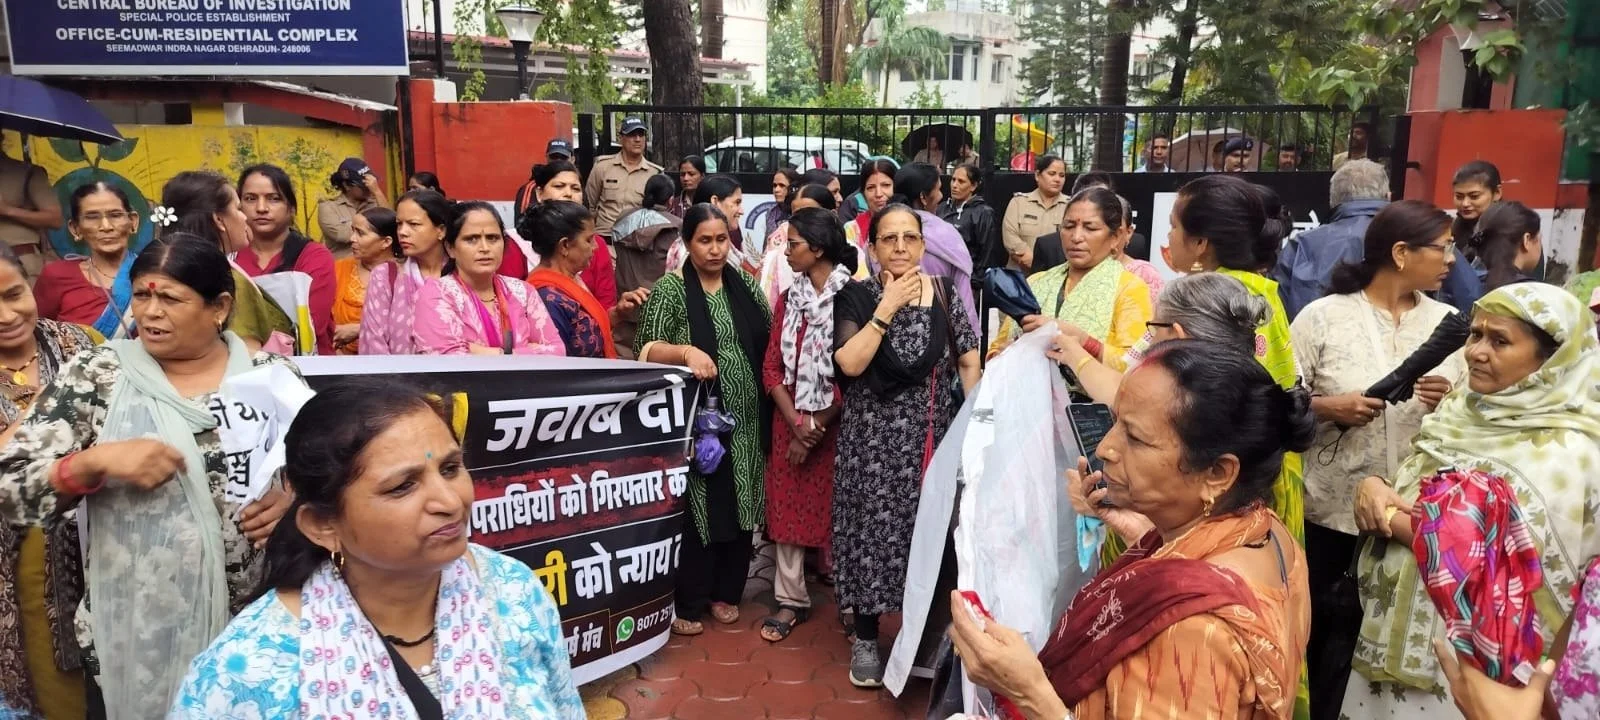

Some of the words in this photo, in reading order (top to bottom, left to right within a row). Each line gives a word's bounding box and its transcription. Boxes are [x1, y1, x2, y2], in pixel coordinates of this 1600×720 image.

[57, 0, 131, 10] CENTRAL
[135, 0, 198, 10] BUREAU
[203, 0, 225, 10] OF
[229, 0, 351, 11] INVESTIGATION
[119, 12, 164, 22] SPECIAL
[166, 12, 204, 22] POLICE
[206, 13, 291, 23] ESTABLISHMENT
[55, 28, 273, 42] OFFICE-CUM-RESIDENTIAL
[277, 29, 358, 42] COMPLEX
[106, 44, 163, 53] SEEMADWAR
[165, 44, 193, 53] INDRA
[194, 45, 226, 53] NAGAR
[228, 45, 280, 54] DEHRADUN-
[282, 45, 311, 54] 248006
[486, 391, 637, 451] जवाब
[466, 479, 556, 538] पराधियों
[557, 474, 587, 518] को
[590, 469, 665, 513] गिरफ्तार
[571, 541, 613, 600] को
[636, 610, 660, 632] 8077
